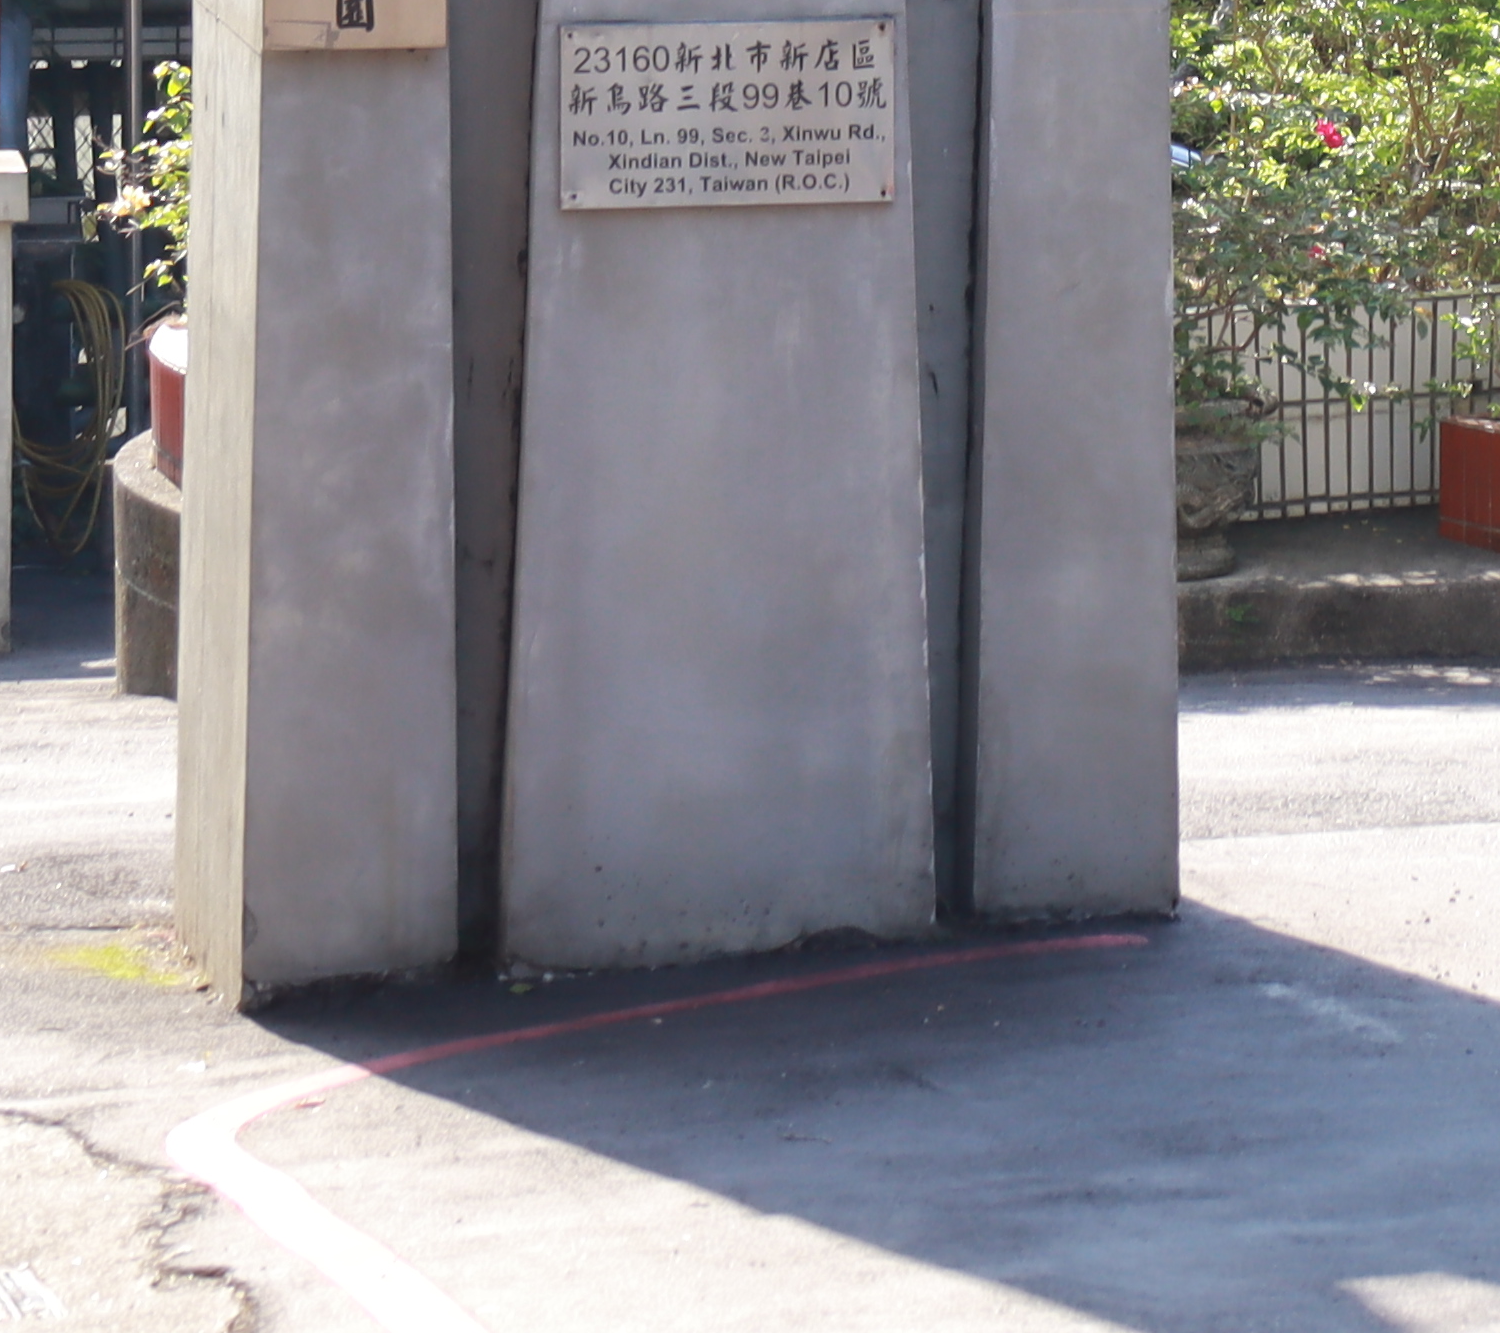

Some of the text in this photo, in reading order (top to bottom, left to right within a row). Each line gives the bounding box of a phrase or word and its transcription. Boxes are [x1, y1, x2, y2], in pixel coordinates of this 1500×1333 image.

[572, 38, 876, 74] 23160新北市新店區
[568, 76, 887, 117] 新烏路三段99巷10號
[572, 123, 886, 148] No.10, Ln. 99, Sec. 3, Xinwu Rd.,
[608, 148, 851, 171] Xindian Dist., New Taipei
[608, 172, 850, 199] City 231, Taiwan (R.O.C.)
